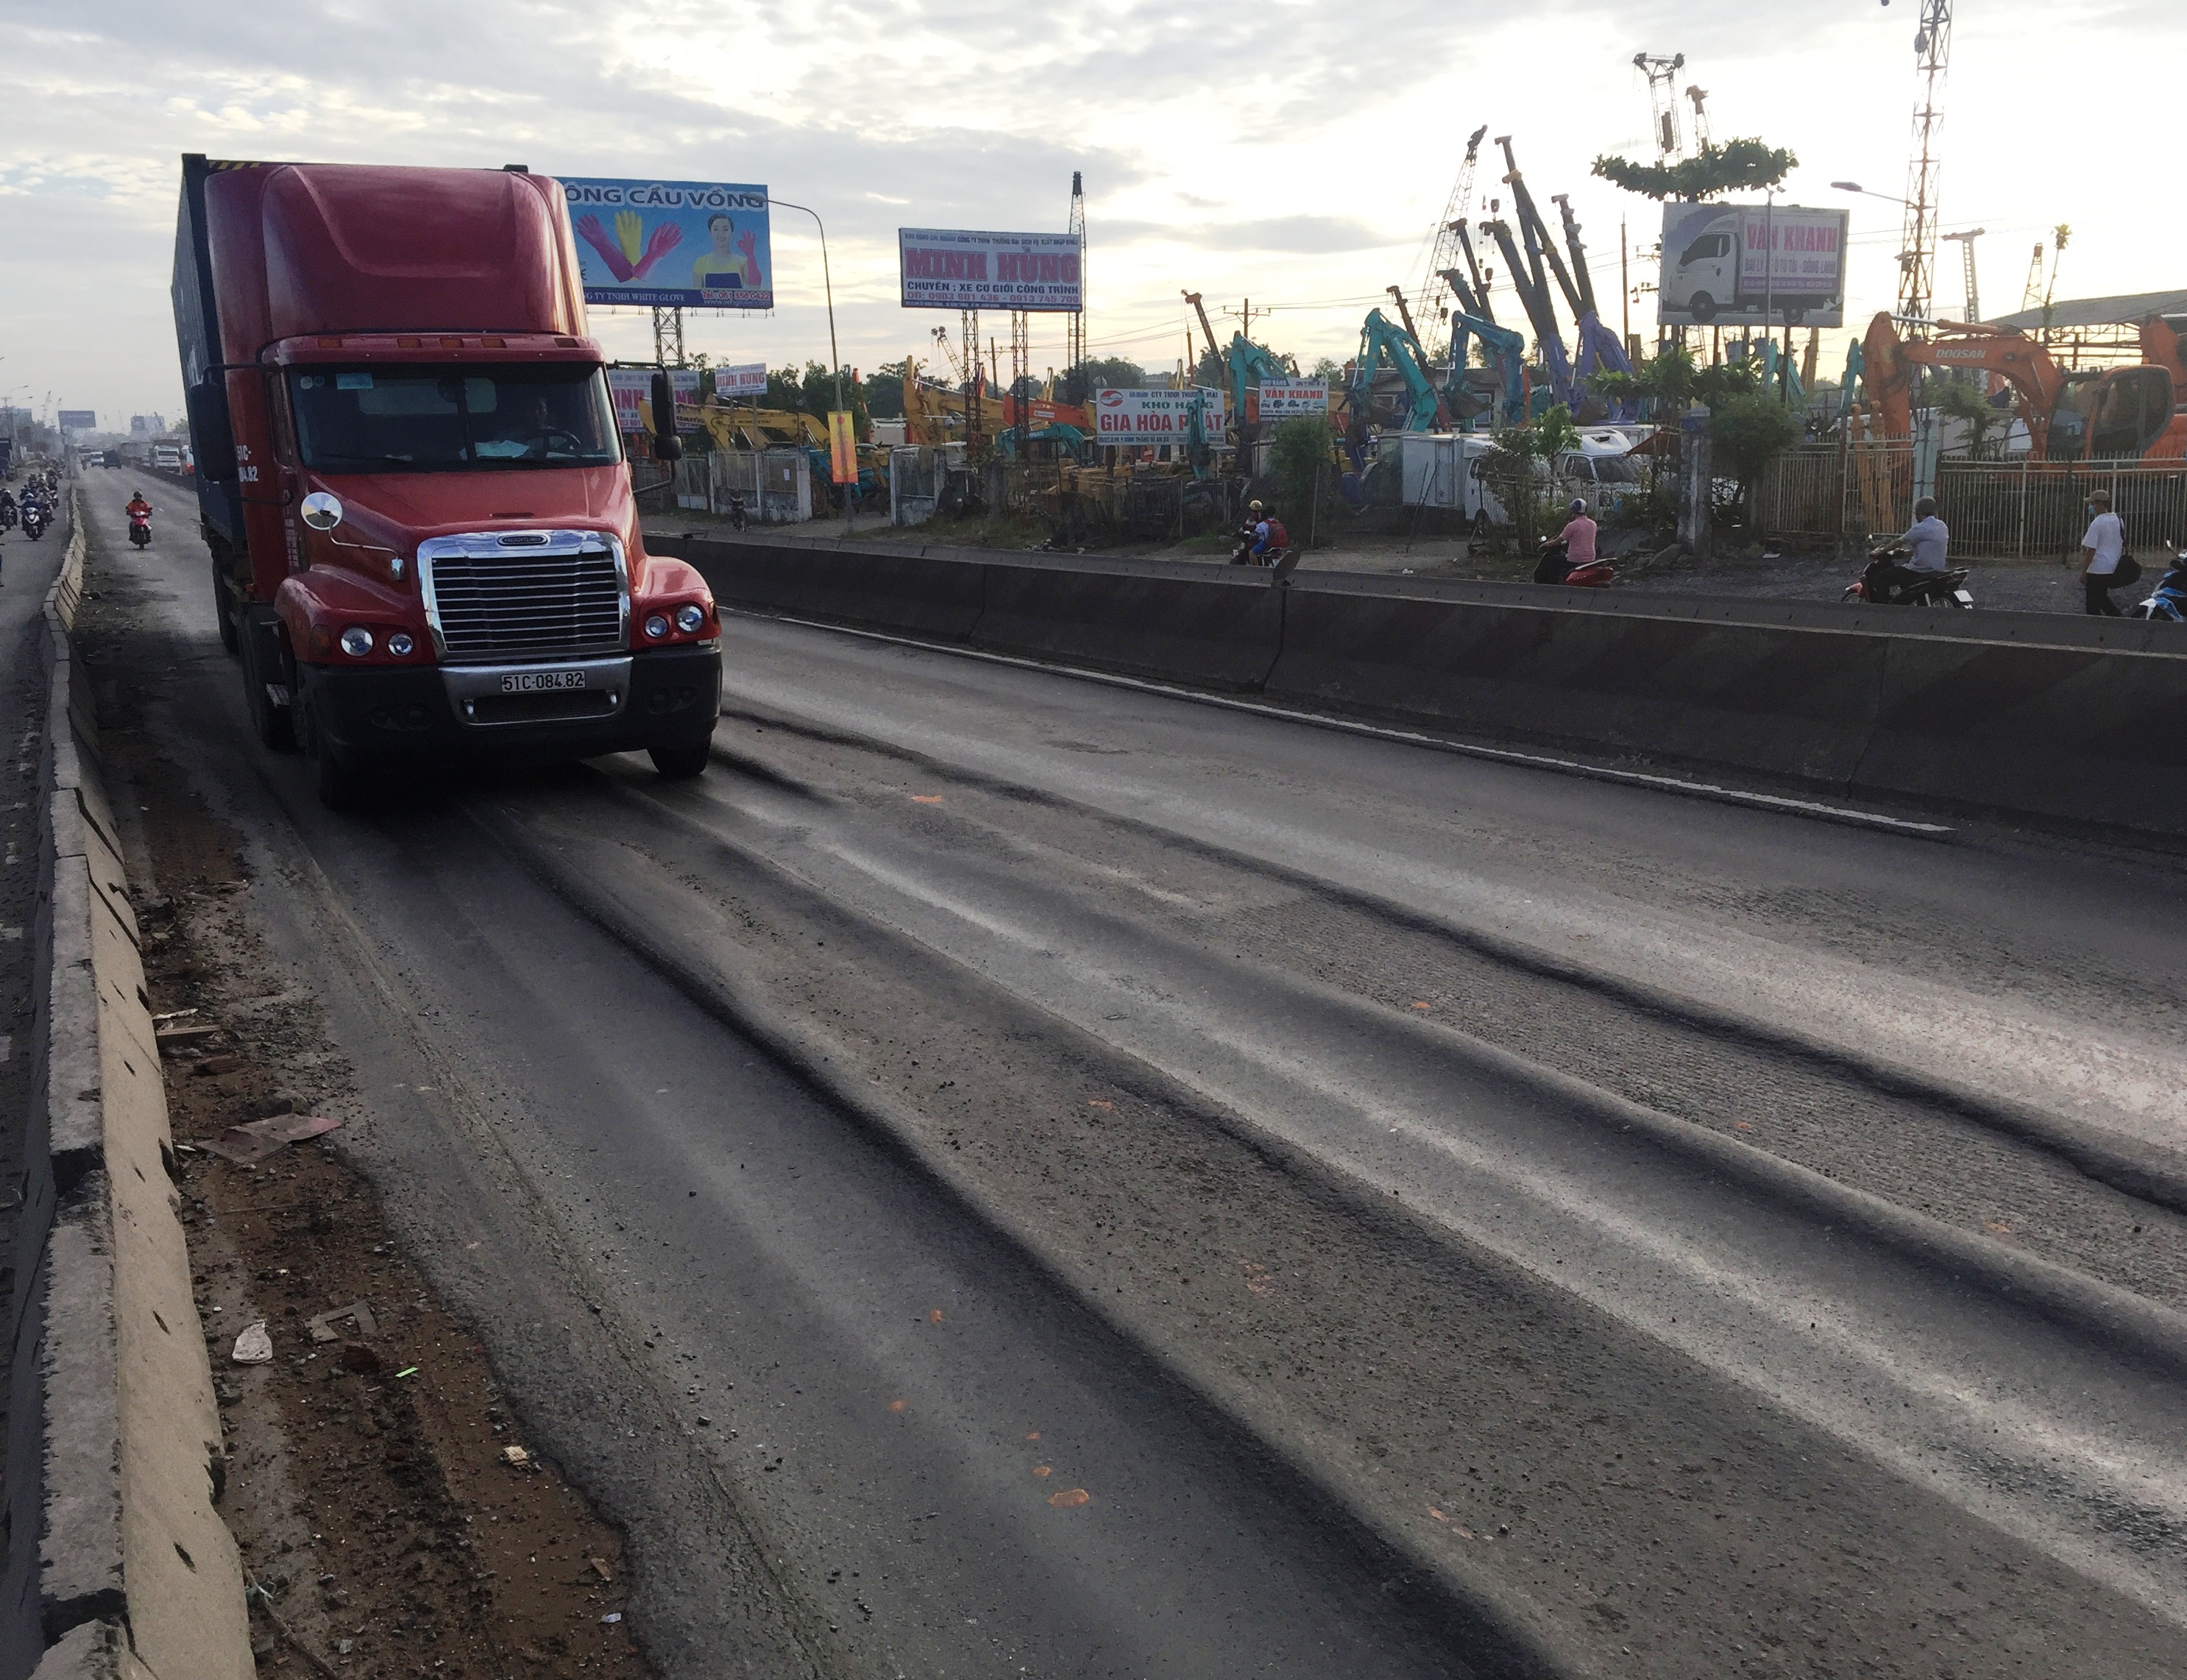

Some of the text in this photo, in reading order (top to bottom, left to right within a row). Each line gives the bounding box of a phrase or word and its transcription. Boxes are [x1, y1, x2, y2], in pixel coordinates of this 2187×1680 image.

[1784, 225, 1837, 252] KHANH
[905, 246, 1080, 283] MINH HÙNG
[907, 281, 950, 291] CHUYÊN
[960, 283, 973, 291] XE
[976, 283, 990, 292] CƠ
[993, 283, 1013, 293] GIỚI
[1017, 284, 1045, 294] CÔNG
[1048, 285, 1078, 294] TRÌNH
[606, 292, 630, 300] TNHH
[631, 293, 658, 301] WHITE
[659, 293, 686, 302] GLOVE
[1935, 349, 1987, 358] DOOSAN
[1289, 390, 1323, 399] KHANH
[1100, 411, 1222, 431] GIA HÒA PÁT
[503, 673, 584, 690] 51C-084.82
